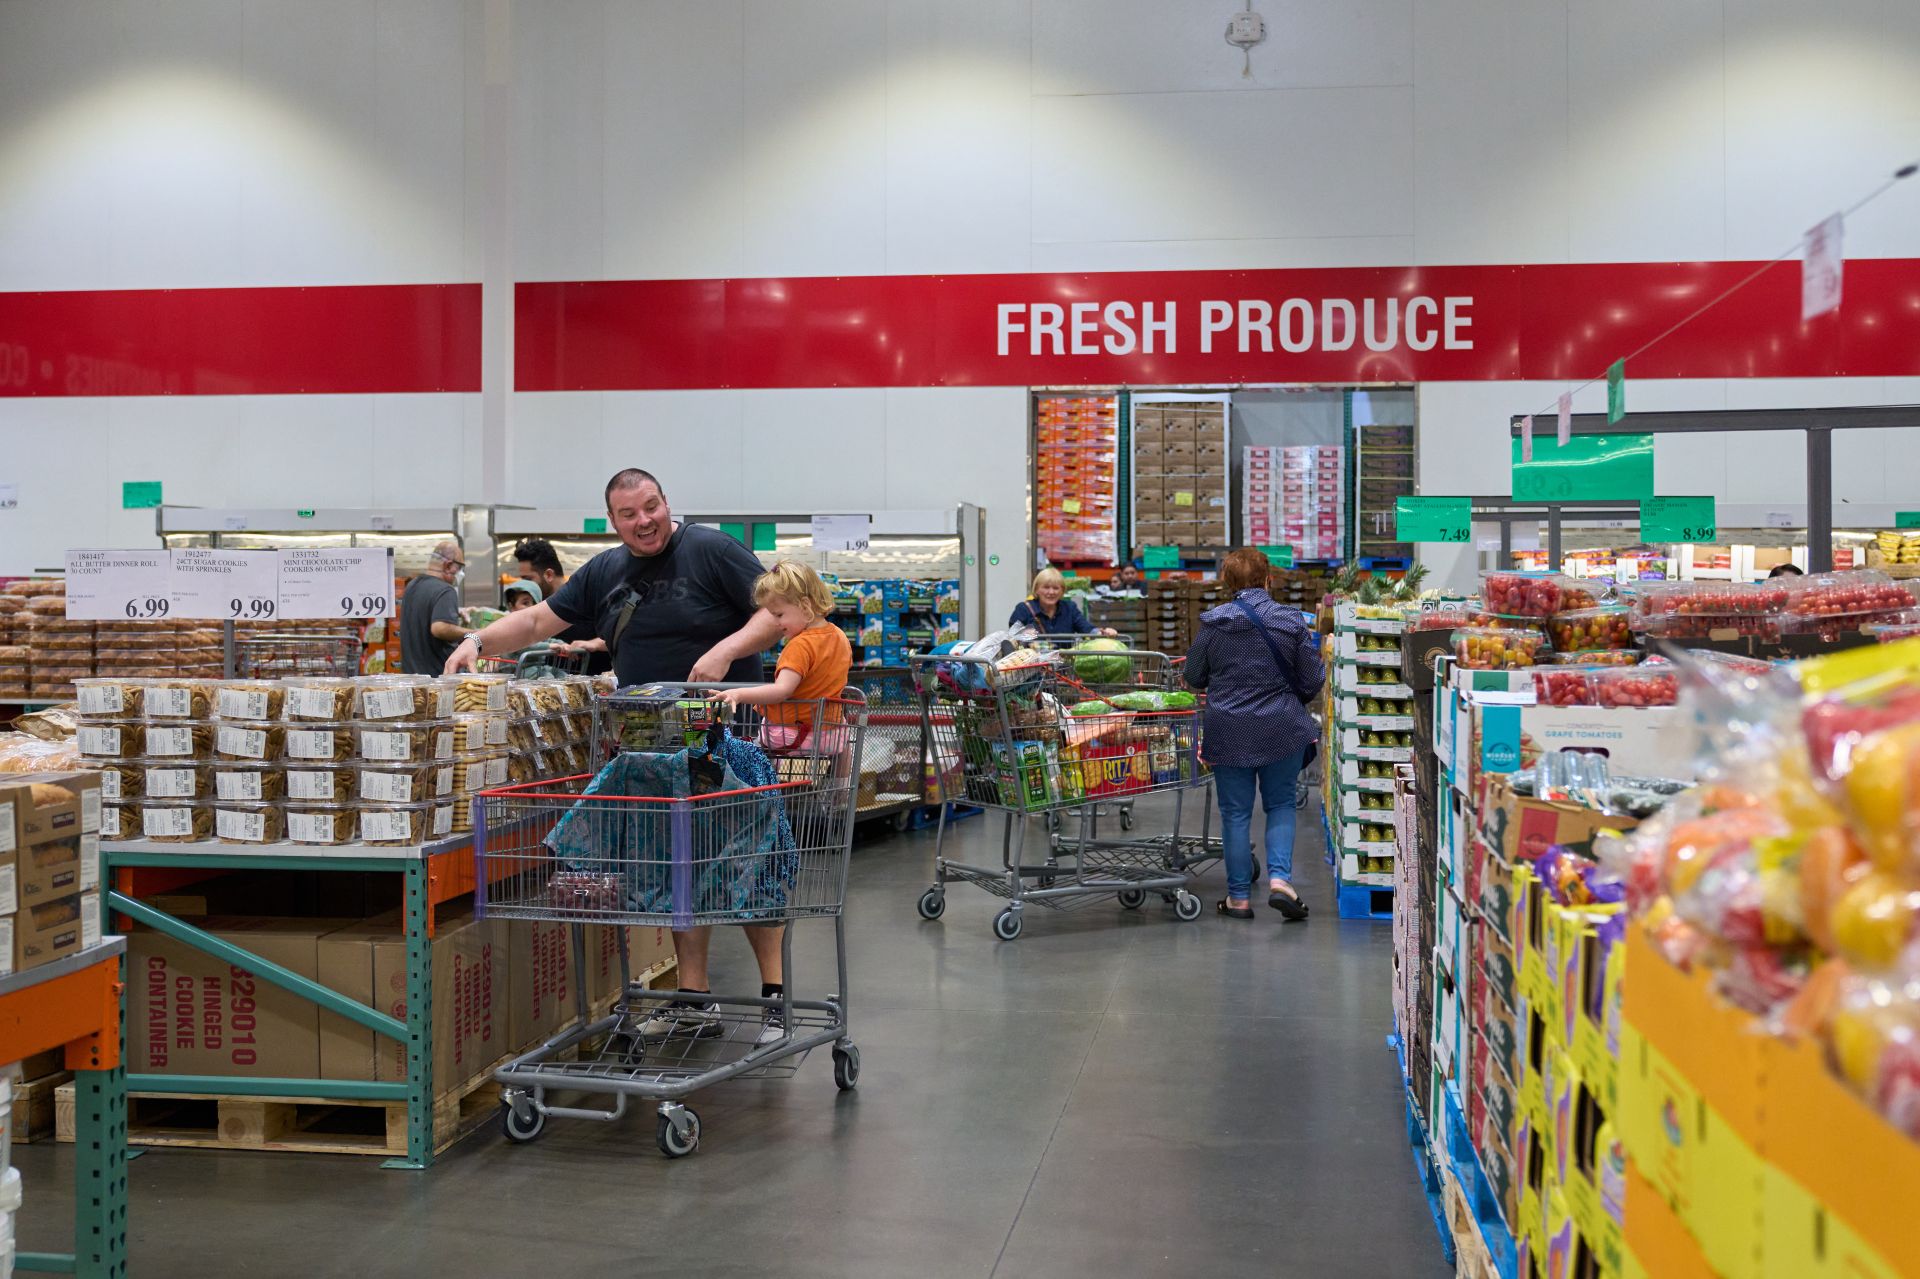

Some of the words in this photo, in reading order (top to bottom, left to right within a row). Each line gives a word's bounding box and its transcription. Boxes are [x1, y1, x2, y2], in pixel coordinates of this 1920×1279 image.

[997, 301, 1177, 356] FRESH
[1200, 296, 1474, 353] PRODUCE
[1439, 528, 1470, 541] 7.49
[1683, 527, 1714, 541] 8.99
[846, 540, 869, 551] 1.99
[302, 558, 343, 566] CHOCOLATE
[125, 598, 170, 618] 6.99
[230, 598, 275, 618] 9.99
[341, 596, 386, 616] 9.99
[1545, 730, 1573, 738] GRAPE
[1576, 731, 1623, 739] TOMATOES
[1102, 756, 1132, 780] RITZ
[482, 942, 492, 1042] 329010
[148, 956, 168, 1068] CONTAINER
[175, 976, 194, 1049] COOKIE
[203, 976, 222, 1050] HINGED
